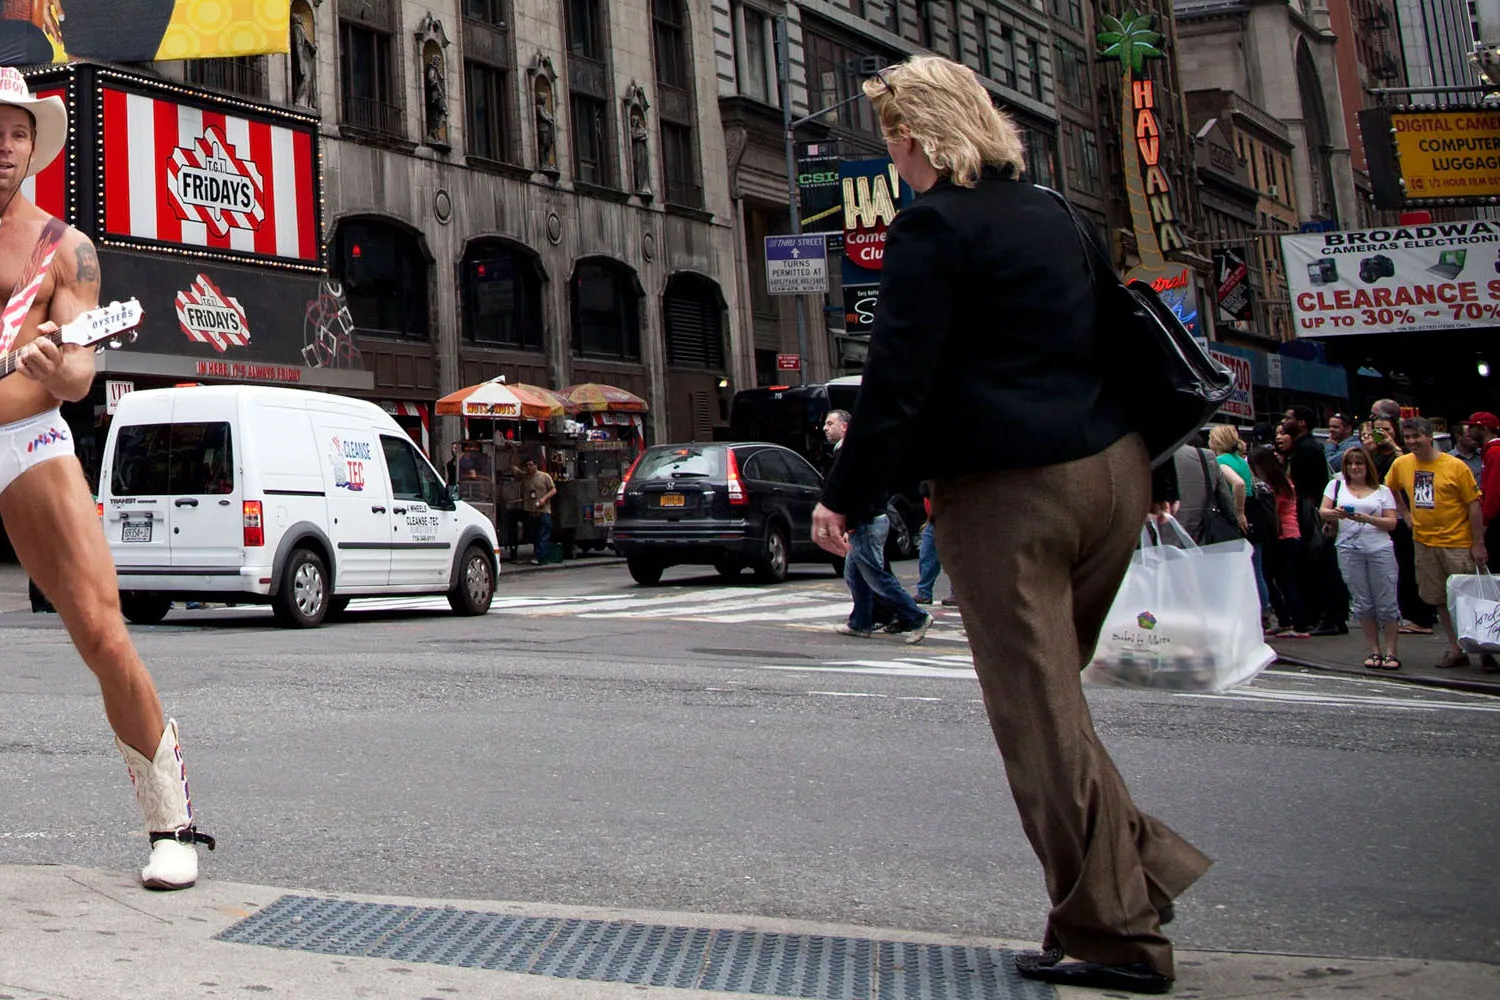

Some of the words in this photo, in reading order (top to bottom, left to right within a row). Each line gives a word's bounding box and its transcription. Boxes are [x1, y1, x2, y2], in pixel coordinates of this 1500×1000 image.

[1396, 117, 1450, 133] DIGITAL
[1455, 115, 1500, 131] CAME
[207, 160, 225, 173] T.G.I.
[1133, 80, 1184, 252] HAVANA
[799, 171, 840, 185] CSI:
[1443, 178, 1467, 188] HOUR
[1469, 177, 1487, 187] FILM
[777, 239, 797, 247] THRU
[798, 238, 823, 246] STREET
[847, 231, 887, 244] Come
[1321, 241, 1399, 255] CAMERAS
[783, 260, 810, 268] TURNS
[772, 269, 812, 277] PERMITTED
[813, 268, 822, 276] AT
[1297, 281, 1479, 312] CLEARANCE
[92, 309, 134, 330] OYSTERS
[1301, 317, 1326, 329] UP
[1330, 316, 1355, 327] TO
[1362, 308, 1416, 326] 30%
[196, 361, 207, 375] IN
[248, 365, 275, 381] ALWAYS
[277, 367, 301, 382] FRIDAY
[110, 383, 131, 400] ATM
[343, 440, 371, 460] CLEANSE
[347, 460, 365, 488] TEC
[406, 516, 428, 527] CLEANSE
